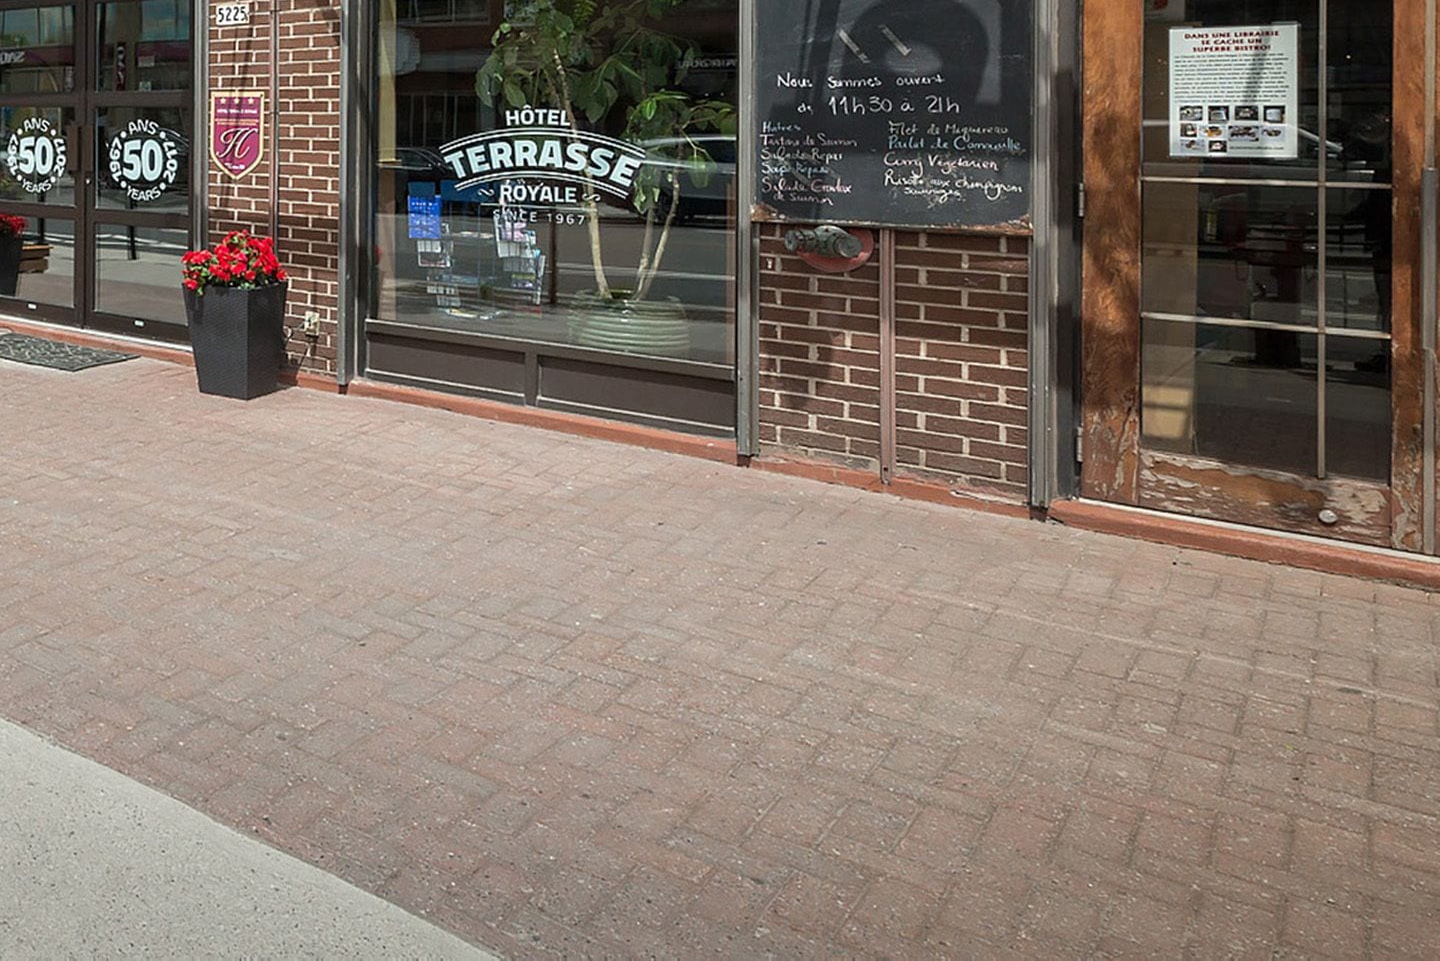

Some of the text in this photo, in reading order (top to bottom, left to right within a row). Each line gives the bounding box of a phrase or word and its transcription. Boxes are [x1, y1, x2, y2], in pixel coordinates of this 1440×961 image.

[218, 6, 248, 23] 5225
[1234, 30, 1280, 38] LIBRAIRIE
[777, 72, 813, 87] Nous
[505, 105, 571, 126] HÔTEL
[23, 118, 50, 132] ANS
[128, 119, 160, 135] ANS
[19, 136, 54, 175] 50
[53, 138, 67, 177] 2017
[110, 137, 122, 182] 1967
[122, 139, 163, 181] 50
[162, 140, 178, 183] 2017
[444, 140, 641, 188] TERRASSE
[21, 178, 52, 193] YEARS
[127, 185, 161, 201] YEARS
[499, 185, 577, 203] ROYALE
[492, 209, 586, 225] SINCE 1967
